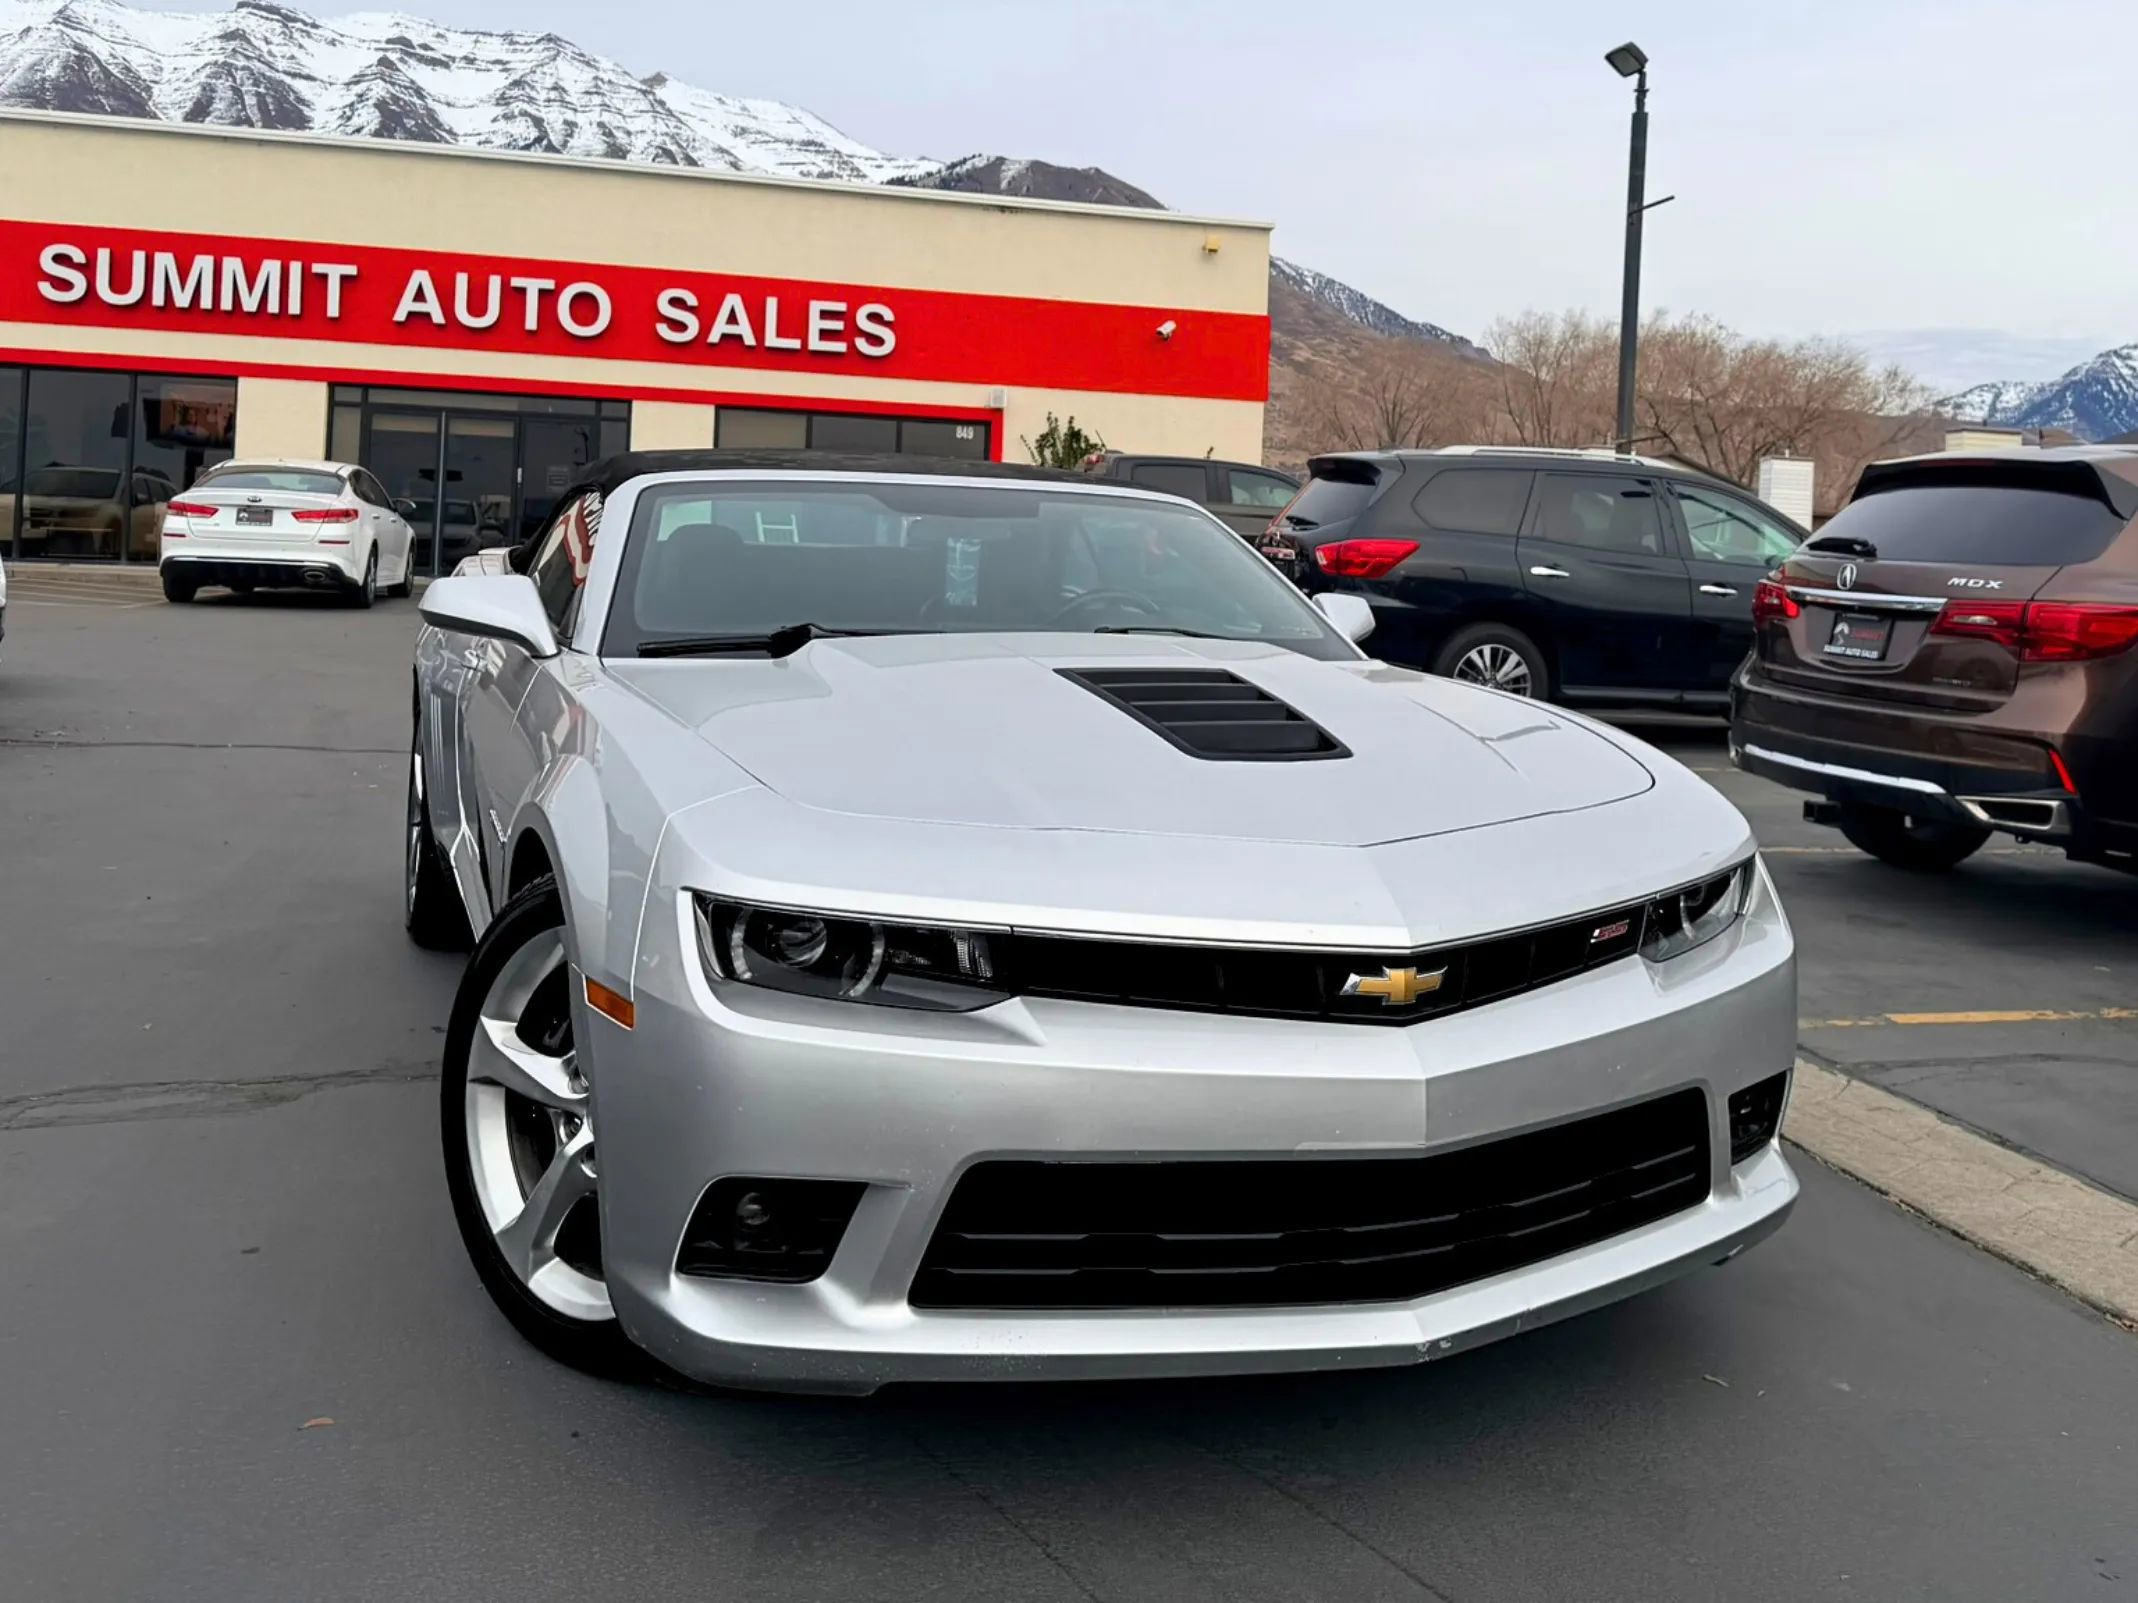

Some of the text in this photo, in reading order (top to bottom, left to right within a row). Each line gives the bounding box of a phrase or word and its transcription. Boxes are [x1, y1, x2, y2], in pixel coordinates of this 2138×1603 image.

[38, 243, 898, 357] SUMMIT AUTO SALES
[1947, 577, 2003, 589] MDX
